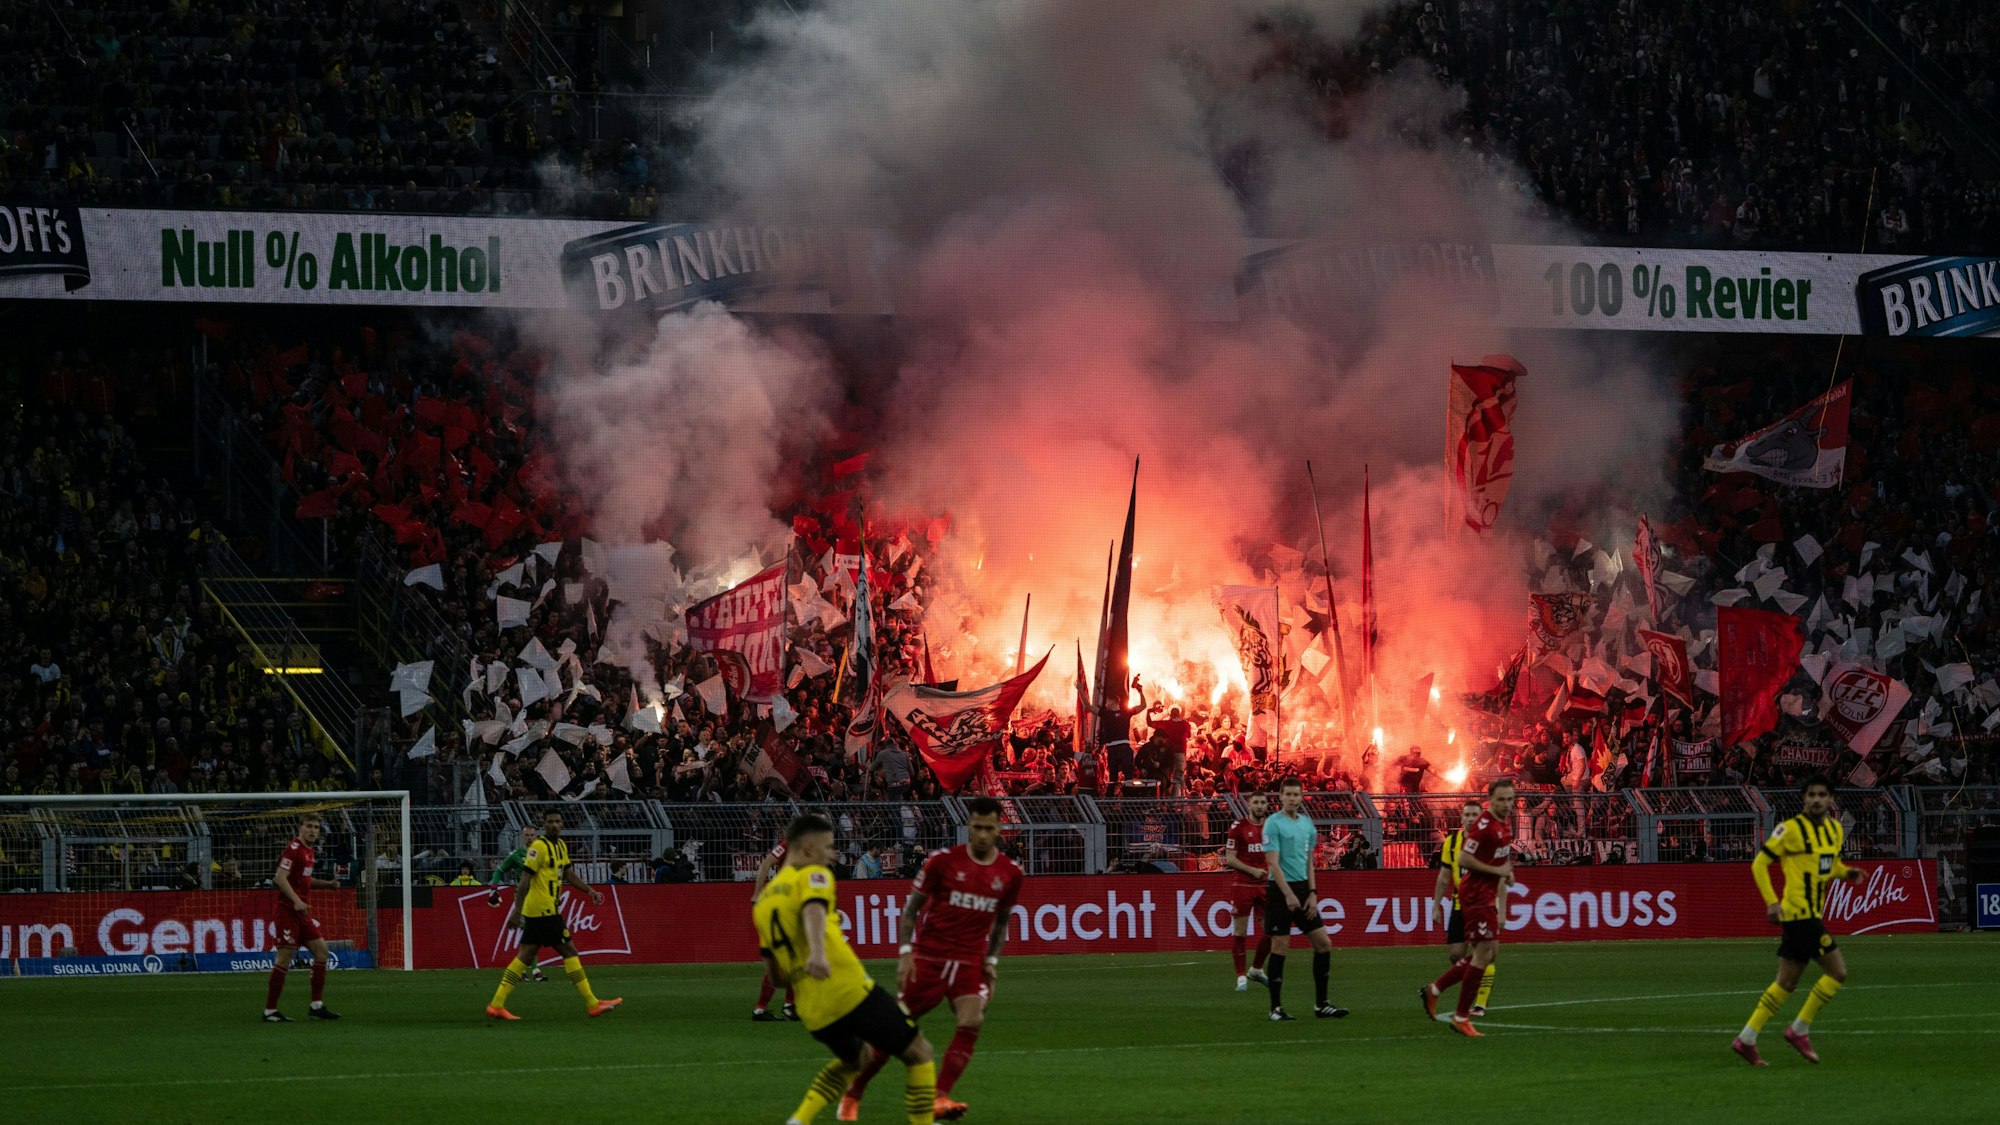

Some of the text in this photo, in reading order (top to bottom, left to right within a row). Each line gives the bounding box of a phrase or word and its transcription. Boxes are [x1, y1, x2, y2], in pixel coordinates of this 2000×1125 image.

[161, 228, 500, 293] Null % Alkohol
[1545, 261, 1811, 321] 100 % Revier
[1879, 261, 2000, 337] BRINK
[1780, 748, 1831, 766] CHAOTIX
[948, 889, 1000, 914] REWE
[1499, 883, 1678, 931] Genuss
[1822, 864, 1911, 922] Melitta
[97, 907, 313, 957] Genu
[771, 908, 797, 961] 4
[53, 962, 142, 976] SIGNAL IDUNA
